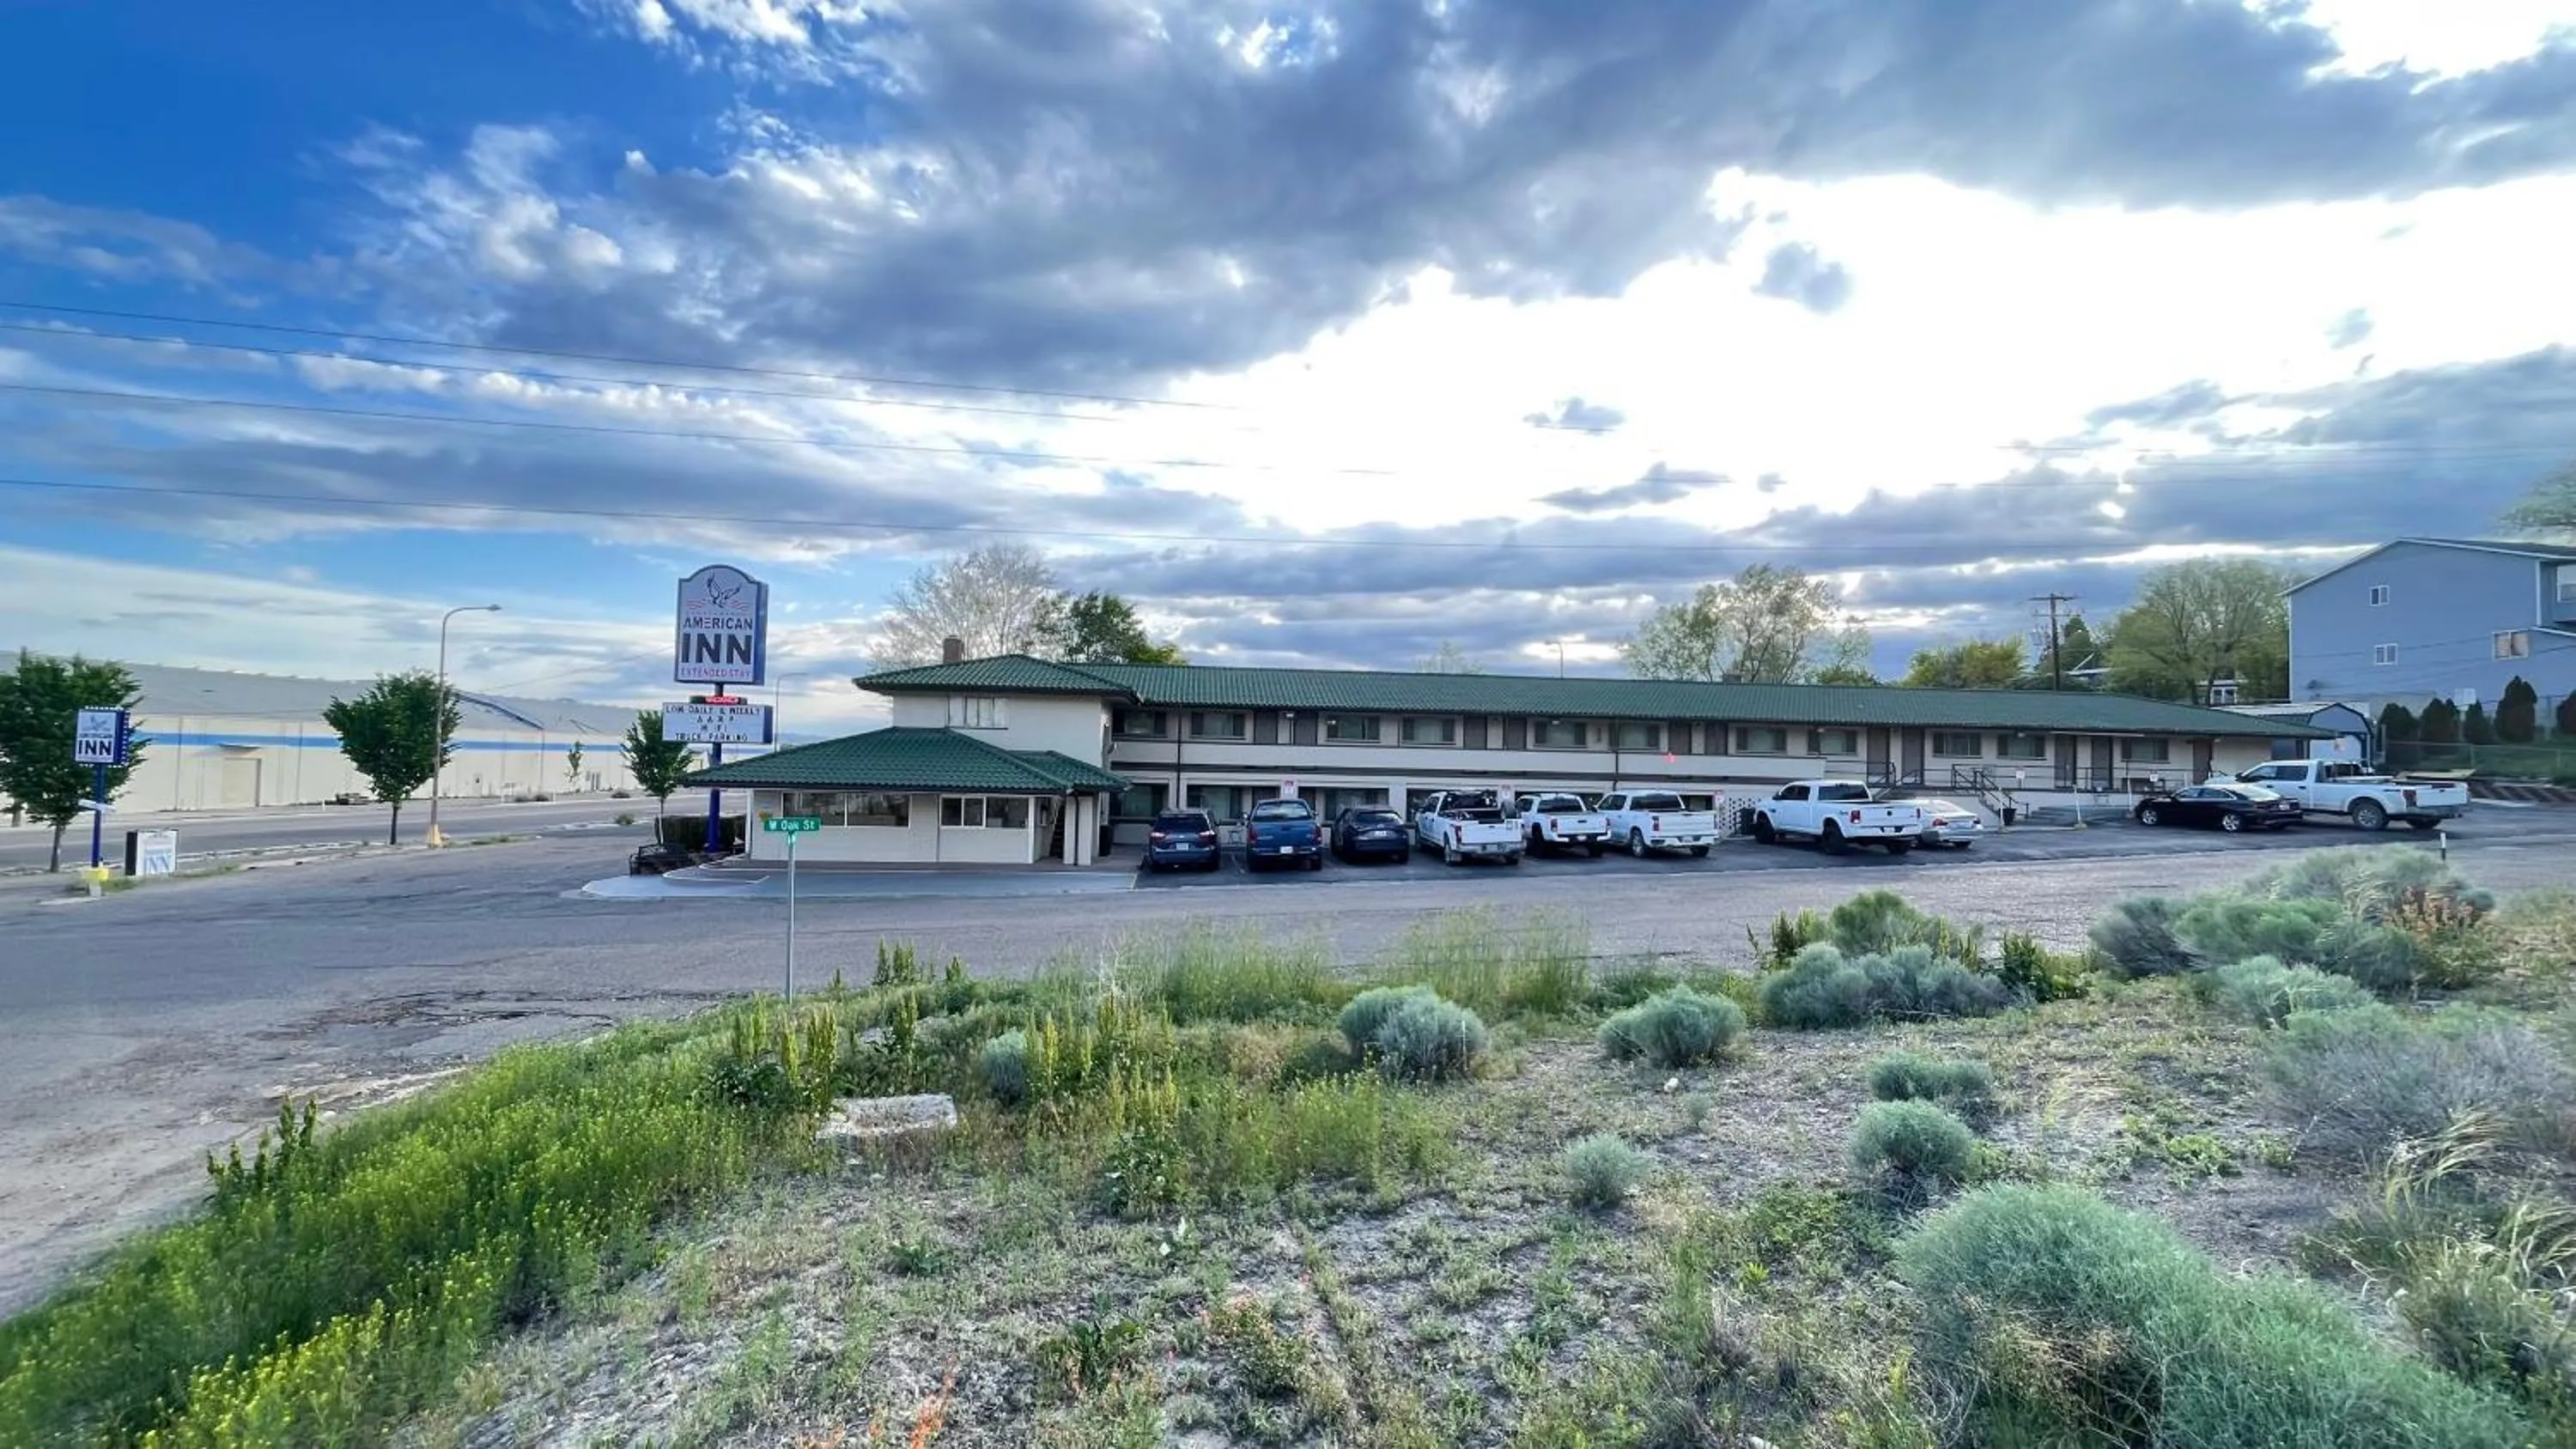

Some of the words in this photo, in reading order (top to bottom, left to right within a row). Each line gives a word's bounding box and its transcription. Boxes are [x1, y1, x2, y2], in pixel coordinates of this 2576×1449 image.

[683, 616, 752, 630] AMERICAN
[681, 633, 752, 665] INN
[681, 667, 726, 677] EXTENDED
[729, 668, 750, 677] STAY
[689, 706, 713, 714] DAILY
[78, 740, 112, 755] INN
[781, 820, 799, 830] Oak
[803, 820, 815, 830] St
